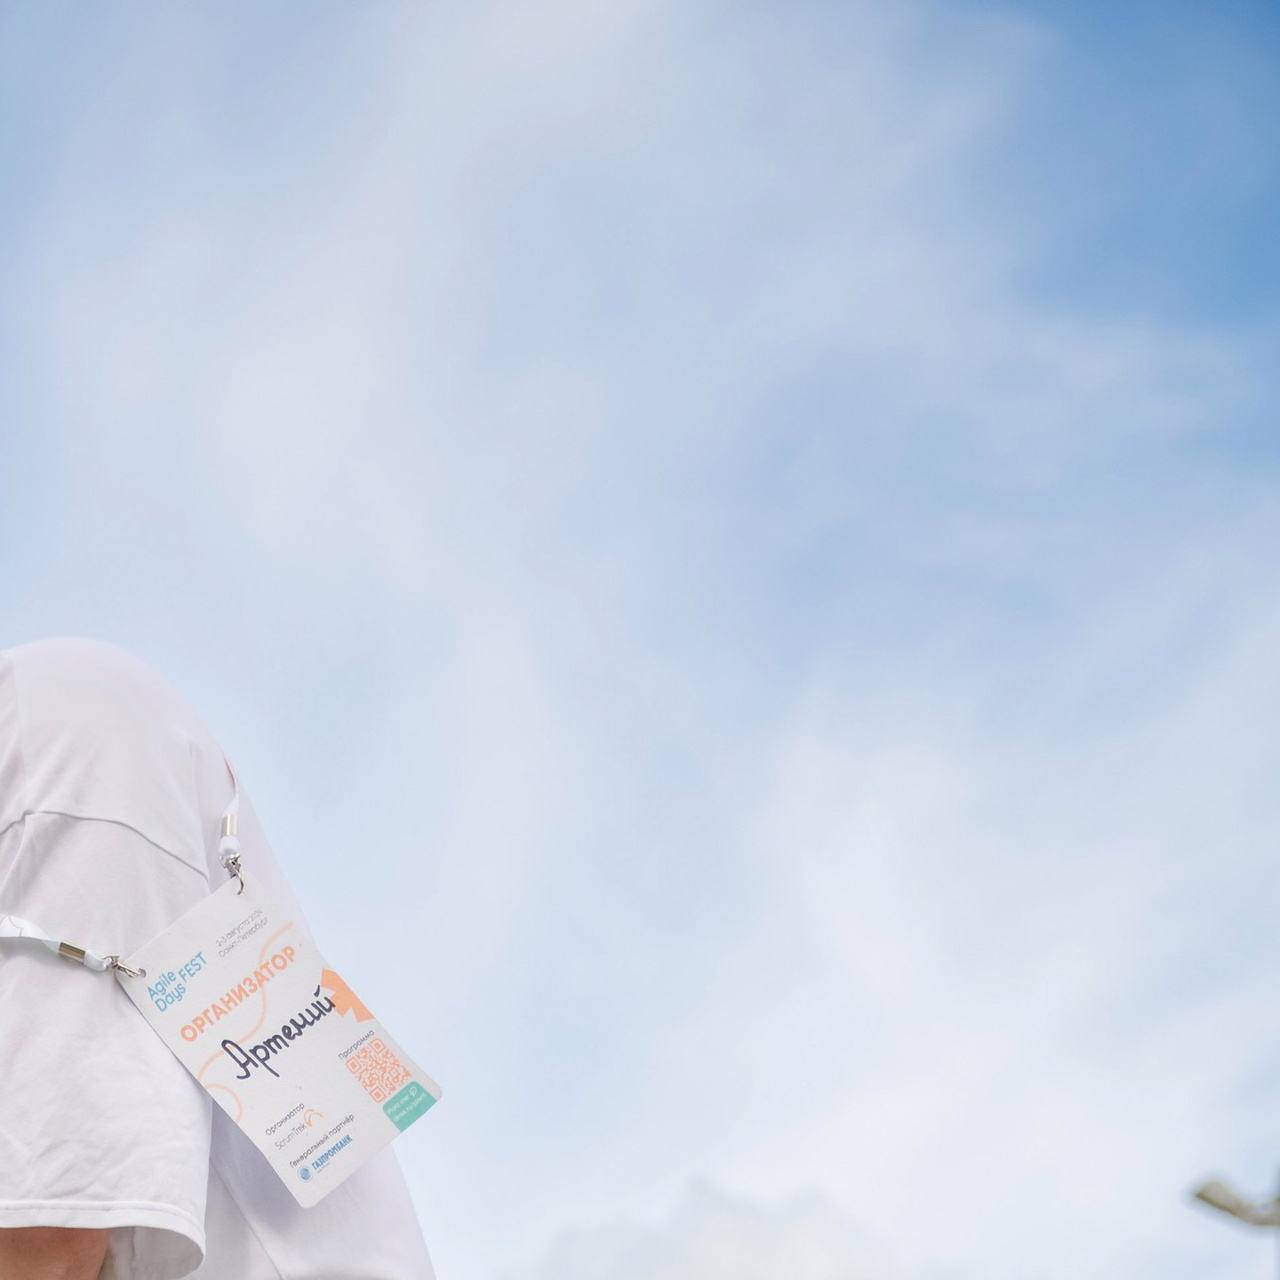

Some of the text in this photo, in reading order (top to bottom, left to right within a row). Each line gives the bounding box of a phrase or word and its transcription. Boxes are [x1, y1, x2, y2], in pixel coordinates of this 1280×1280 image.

[147, 951, 207, 1000] Agile FEST
[155, 983, 186, 1012] Days
[180, 946, 295, 1042] ОРГАНИЗАТОР
[221, 985, 336, 1080] Артемий
[338, 1029, 375, 1060] Программа
[265, 1103, 305, 1136] Организатор
[274, 1122, 308, 1150] ScrumTrek
[290, 1113, 355, 1169] Генеральный партнёр
[311, 1134, 353, 1170] ГАЗПРОМБАНК
